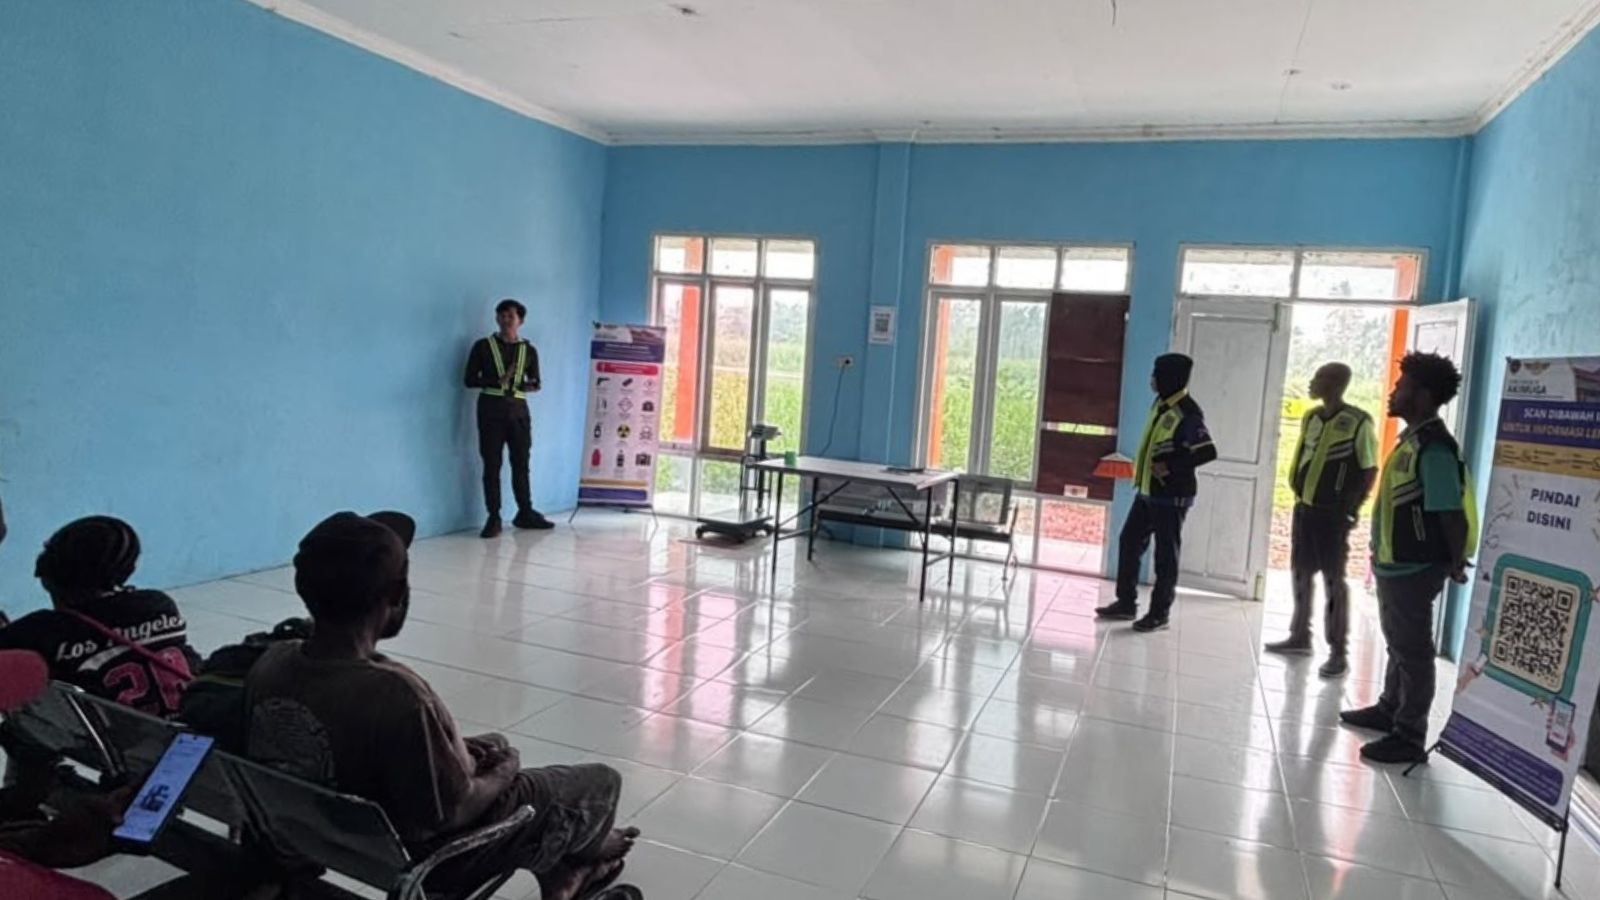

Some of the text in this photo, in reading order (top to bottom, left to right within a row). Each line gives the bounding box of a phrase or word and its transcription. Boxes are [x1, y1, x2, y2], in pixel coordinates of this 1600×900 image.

[1523, 406, 1547, 419] SCAN
[1548, 408, 1594, 422] DIBAWAH
[1530, 488, 1581, 508] PINDAI
[1526, 510, 1572, 531] DISINI
[57, 640, 98, 661] Los
